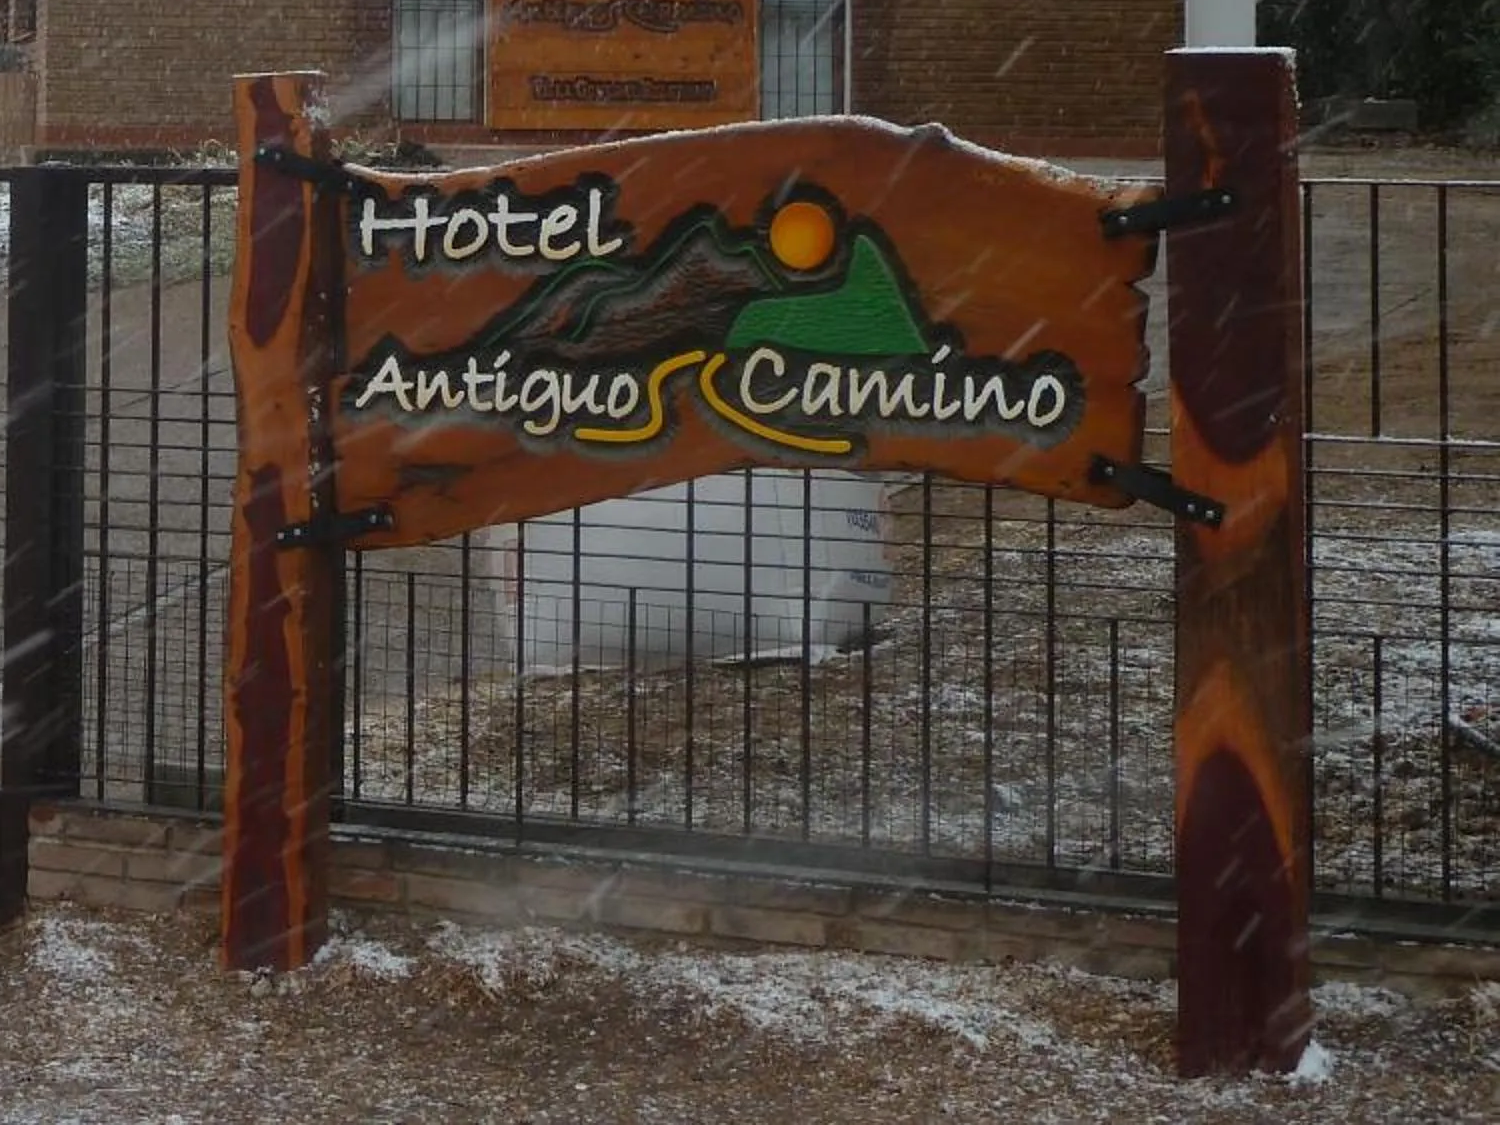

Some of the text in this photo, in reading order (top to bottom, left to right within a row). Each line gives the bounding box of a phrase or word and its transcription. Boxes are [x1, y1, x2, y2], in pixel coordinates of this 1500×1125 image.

[359, 187, 624, 261] Hotel
[355, 344, 1066, 436] Antiguo Camino
